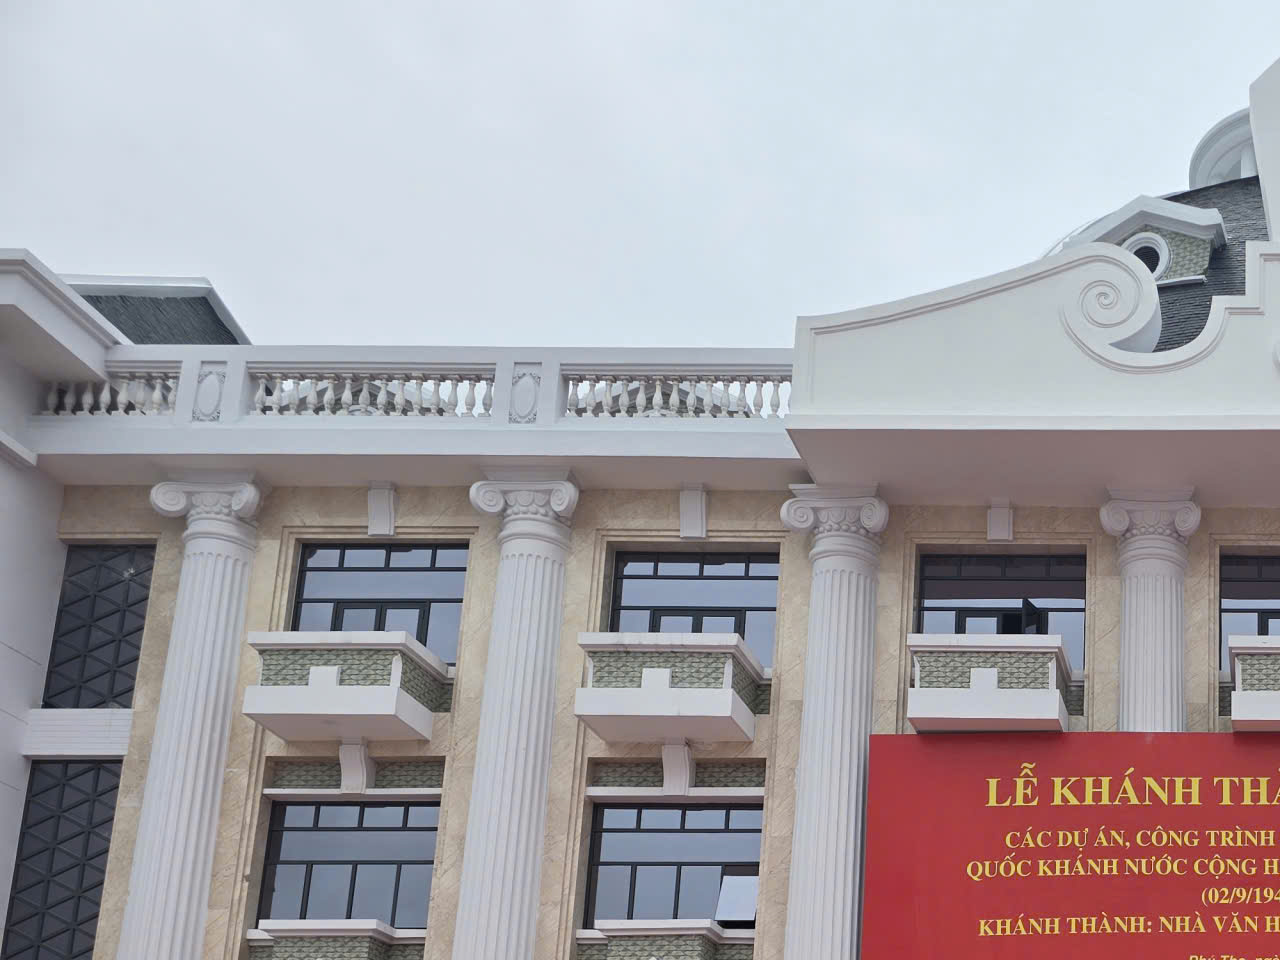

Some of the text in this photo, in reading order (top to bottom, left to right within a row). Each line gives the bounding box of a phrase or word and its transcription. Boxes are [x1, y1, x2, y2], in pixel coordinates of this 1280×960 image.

[984, 762, 1039, 807] LỄ
[1050, 766, 1203, 806] KHÁNH
[1005, 826, 1052, 849] CÁC
[1057, 827, 1089, 852] DỰ
[1093, 825, 1131, 849] ÁN,
[1135, 824, 1201, 847] CÔNG
[1205, 825, 1276, 847] TRÌNH
[966, 851, 1032, 882] QUỐC
[1037, 853, 1119, 877] KHÁNH
[1123, 853, 1188, 876] NƯỚC
[1193, 853, 1258, 880] CỘNG
[978, 912, 1061, 937] KHÁNH
[1066, 911, 1153, 934] THÀNH:
[1158, 911, 1207, 933] NHÀ
[1212, 911, 1259, 933] VĂN
